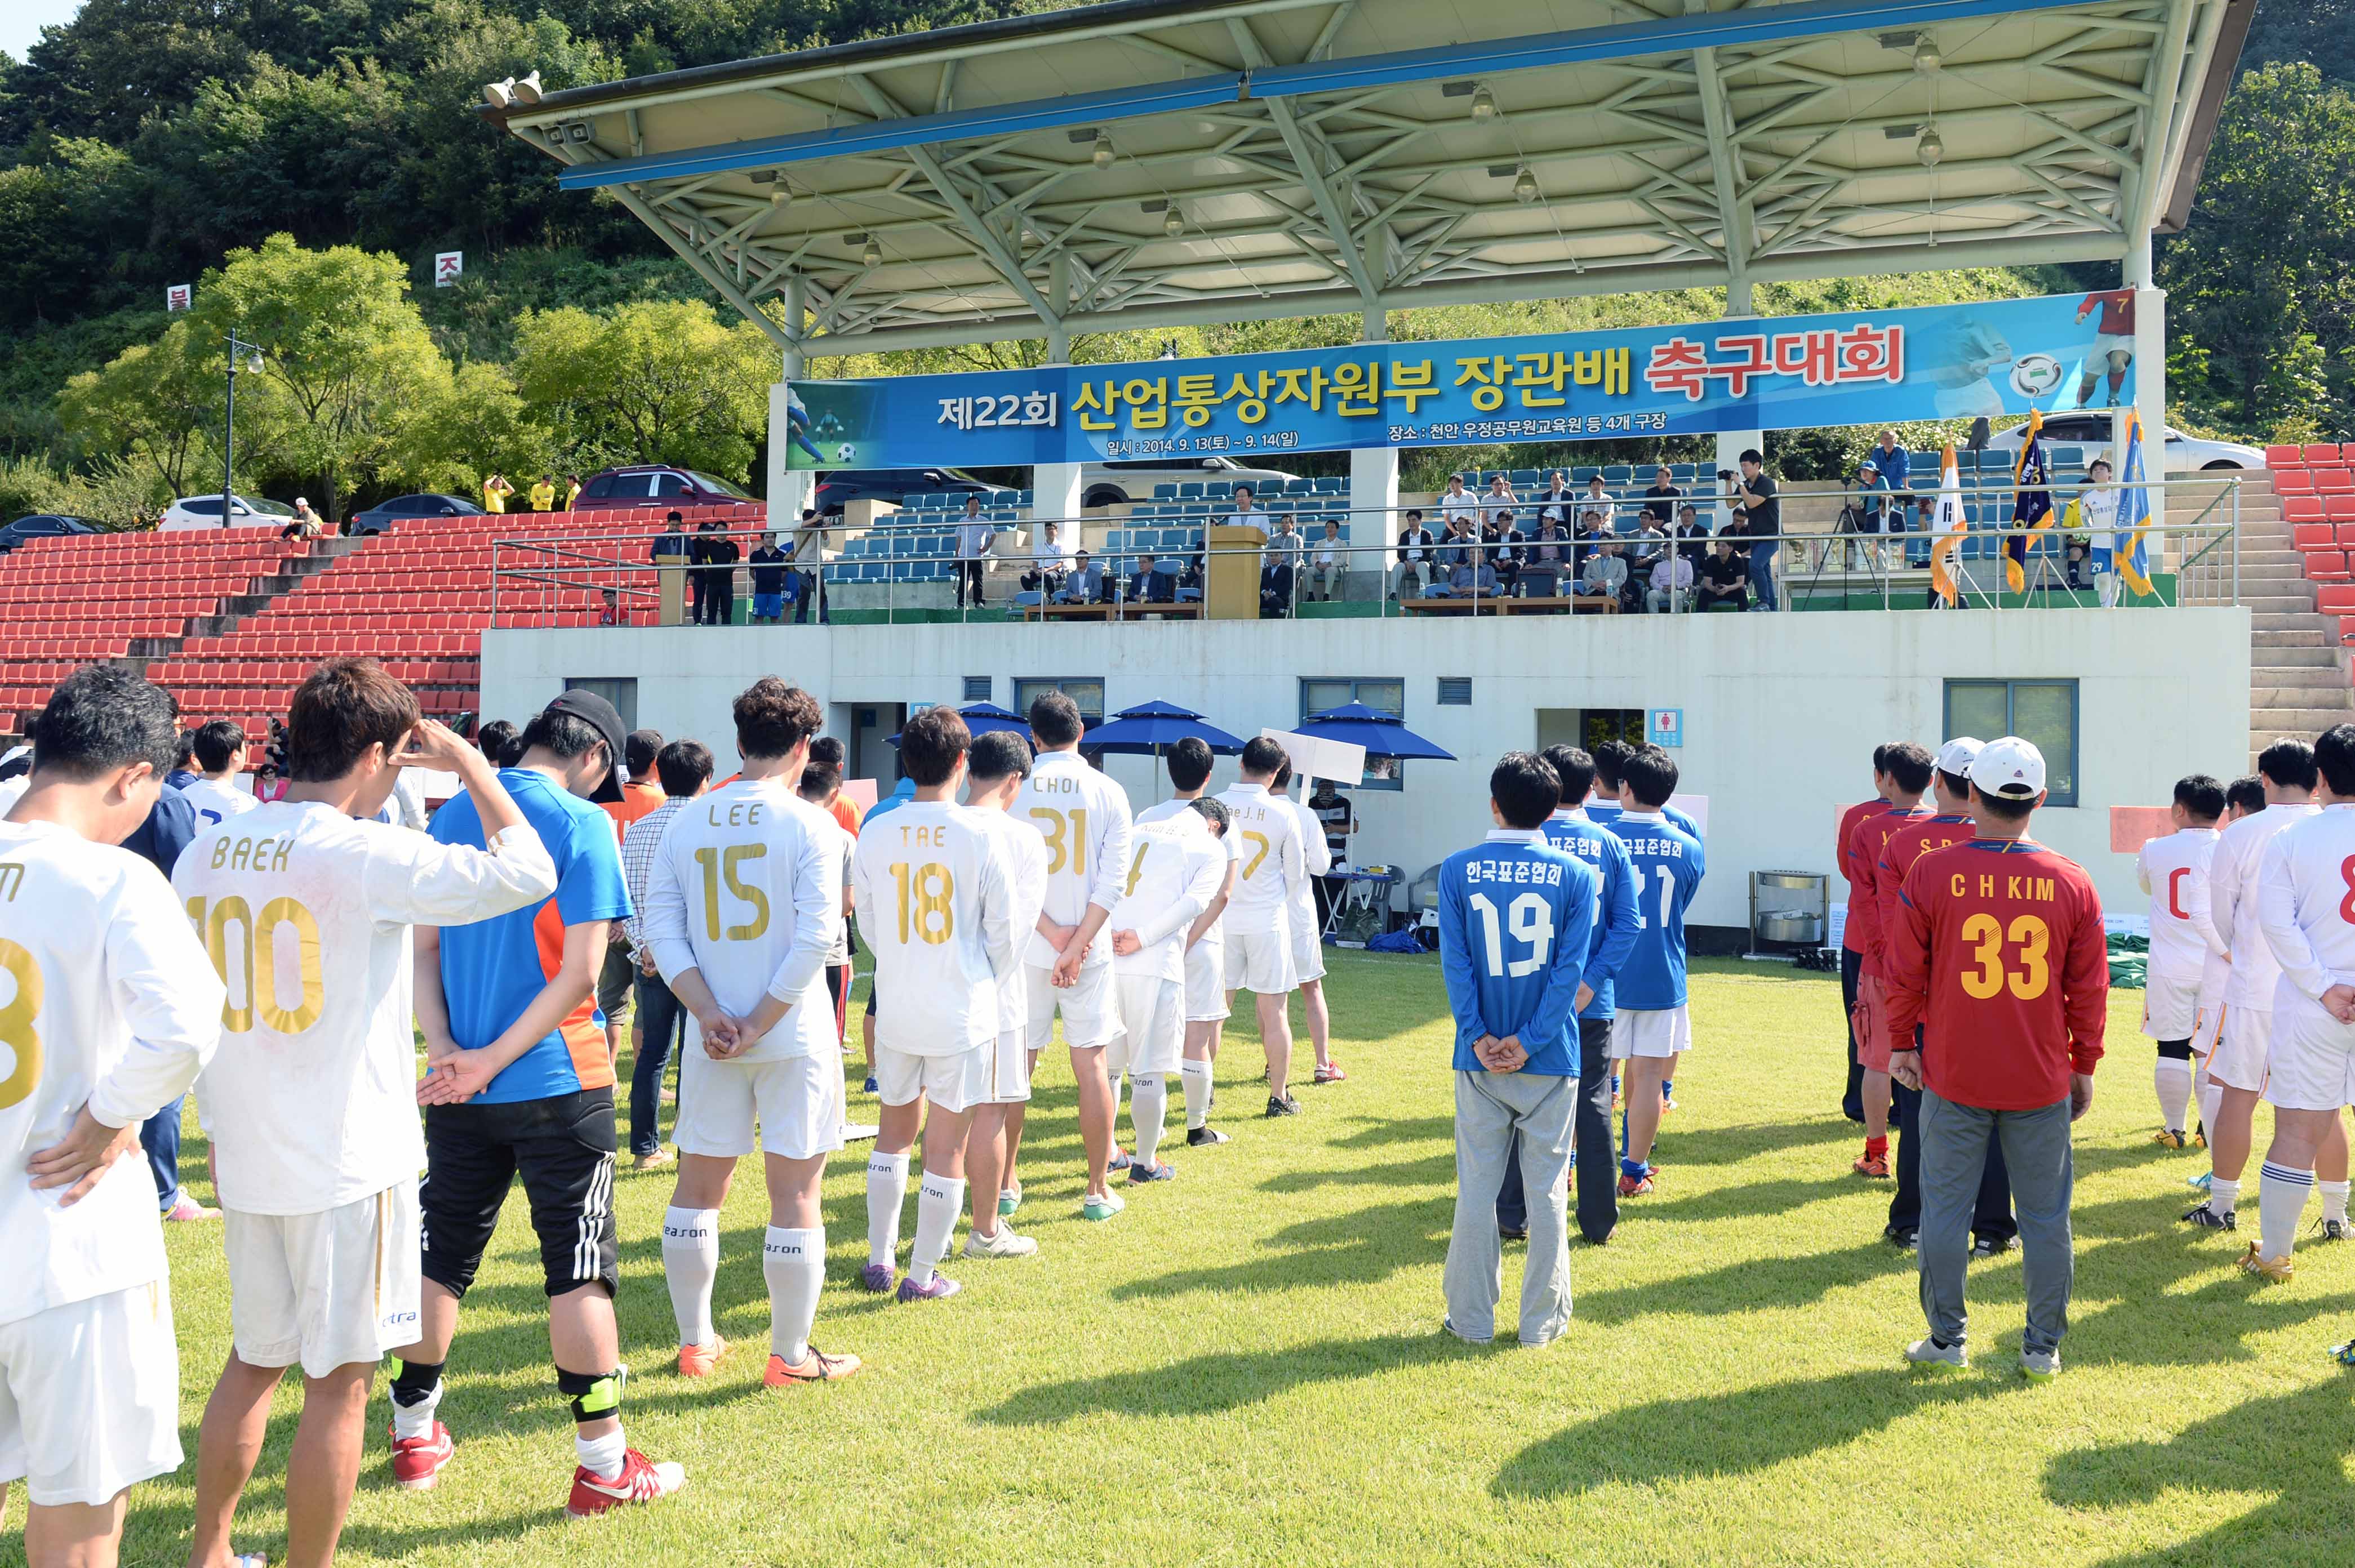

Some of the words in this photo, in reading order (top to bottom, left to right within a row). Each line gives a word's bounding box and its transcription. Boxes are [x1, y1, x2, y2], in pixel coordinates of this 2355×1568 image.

[2117, 297, 2129, 314] 7
[937, 391, 1057, 430] 제22회
[1070, 358, 1440, 431] 산업통상자원부
[1455, 347, 1630, 411] 장관배
[1645, 323, 1904, 401] 축구대회
[1388, 425, 1418, 441] 장소
[1430, 423, 1459, 439] 천안
[1463, 416, 1581, 438] 우정공무원교육원
[1586, 416, 1602, 433] 등
[1605, 413, 1632, 431] 4개
[1634, 412, 1667, 431] 구장
[1107, 440, 1132, 455] 일시
[1143, 439, 1175, 453] 2014.
[1179, 438, 1190, 451] 9.
[1194, 435, 1230, 451] 13(토)
[1246, 435, 1257, 448] 9.
[1261, 431, 1299, 447] 14(일)
[2091, 562, 2103, 572] 29
[1033, 777, 1079, 794] CHOI
[709, 804, 763, 827] LEE
[1227, 807, 1241, 818] ae
[900, 825, 947, 848] TAE
[1029, 808, 1086, 875] 31
[1550, 838, 1602, 858] 표준협회
[1622, 838, 1682, 858] 국표준협회
[211, 836, 295, 872] BAEK
[1466, 859, 1562, 887] 한국표준협회
[694, 843, 770, 941] 15
[2008, 875, 2055, 902] KIM
[888, 862, 954, 945] 18
[1469, 892, 1554, 977] 19
[1961, 913, 2050, 1000] 33
